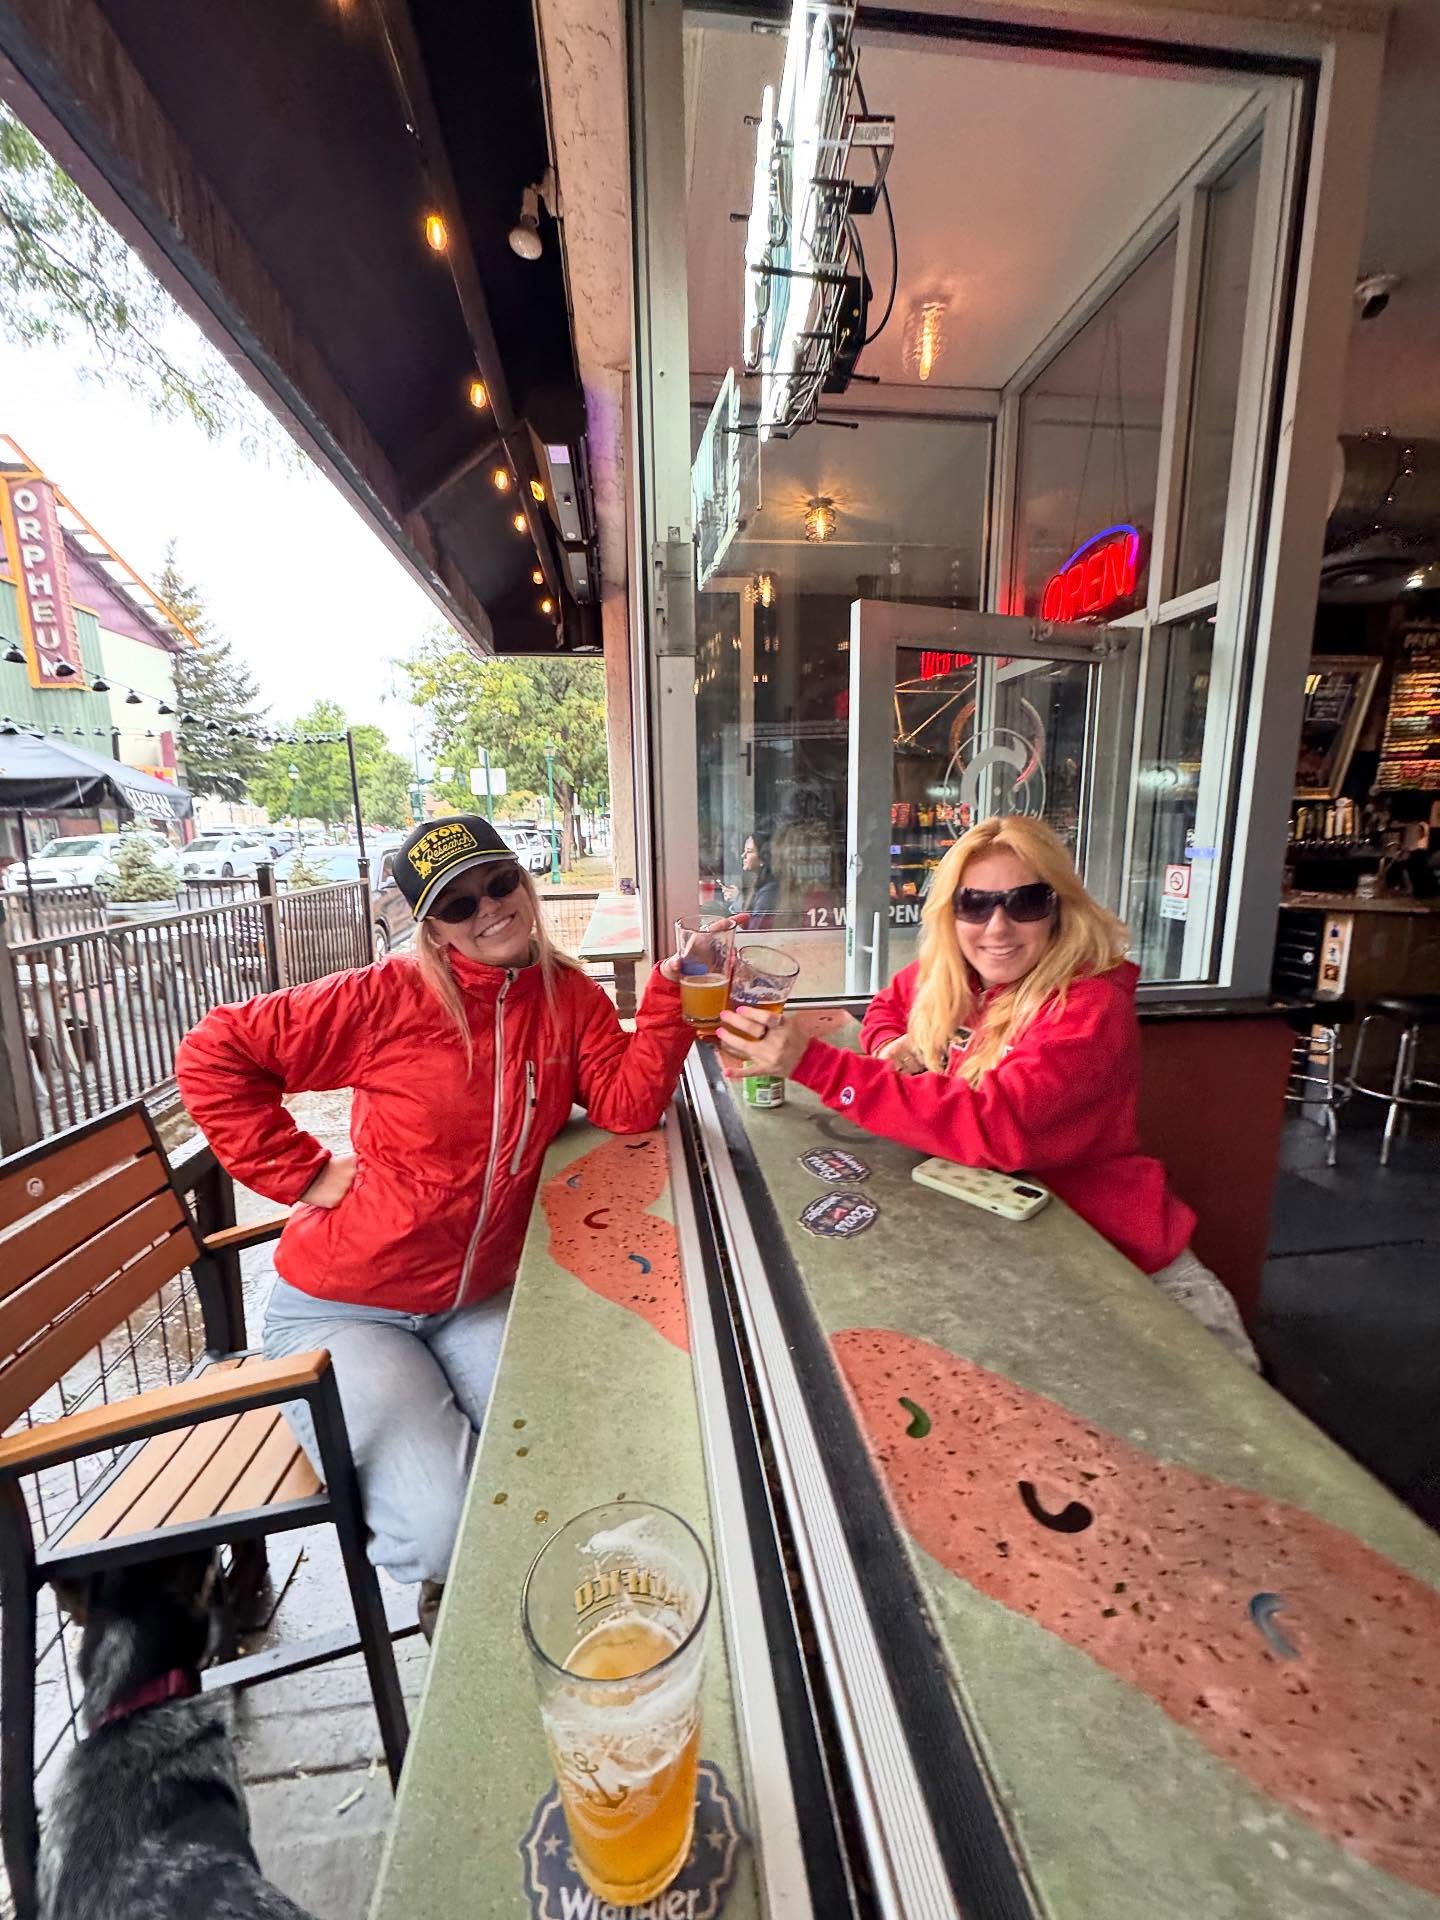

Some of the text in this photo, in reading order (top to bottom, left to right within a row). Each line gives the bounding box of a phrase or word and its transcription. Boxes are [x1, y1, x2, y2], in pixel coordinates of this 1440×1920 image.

[13, 487, 65, 678] ORPHEUM
[1041, 532, 1137, 621] OPEN
[410, 825, 463, 859] TETON
[422, 832, 473, 860] Research
[432, 833, 461, 848] GRAVITY
[806, 907, 828, 927] 12
[834, 1204, 877, 1232] Coors
[559, 1885, 701, 1920] Wraler
